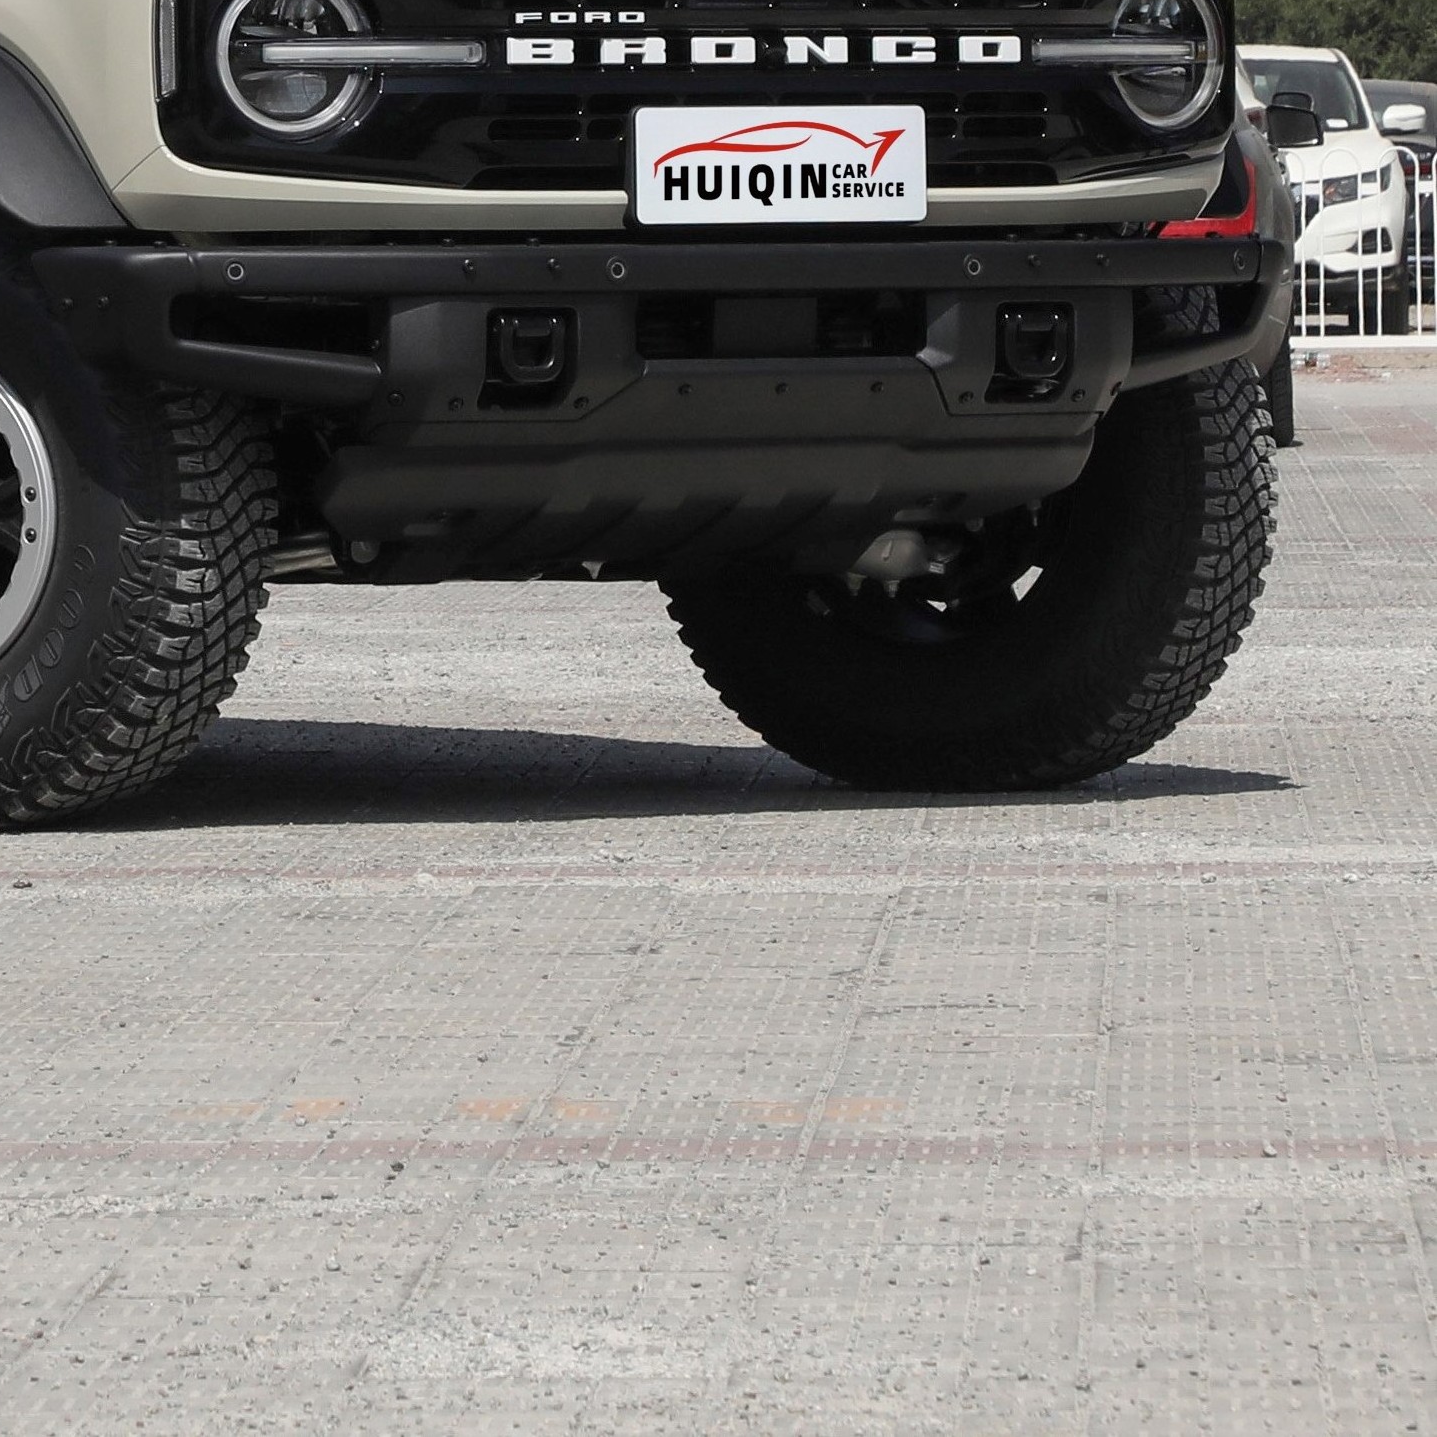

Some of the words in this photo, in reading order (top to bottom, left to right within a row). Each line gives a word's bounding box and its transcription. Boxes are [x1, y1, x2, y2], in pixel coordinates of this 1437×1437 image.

[515, 11, 645, 24] FORD
[506, 35, 1021, 64] BRONCO
[832, 163, 867, 179] CAR
[663, 163, 827, 206] HUIQIN
[832, 182, 905, 199] SERVICE
